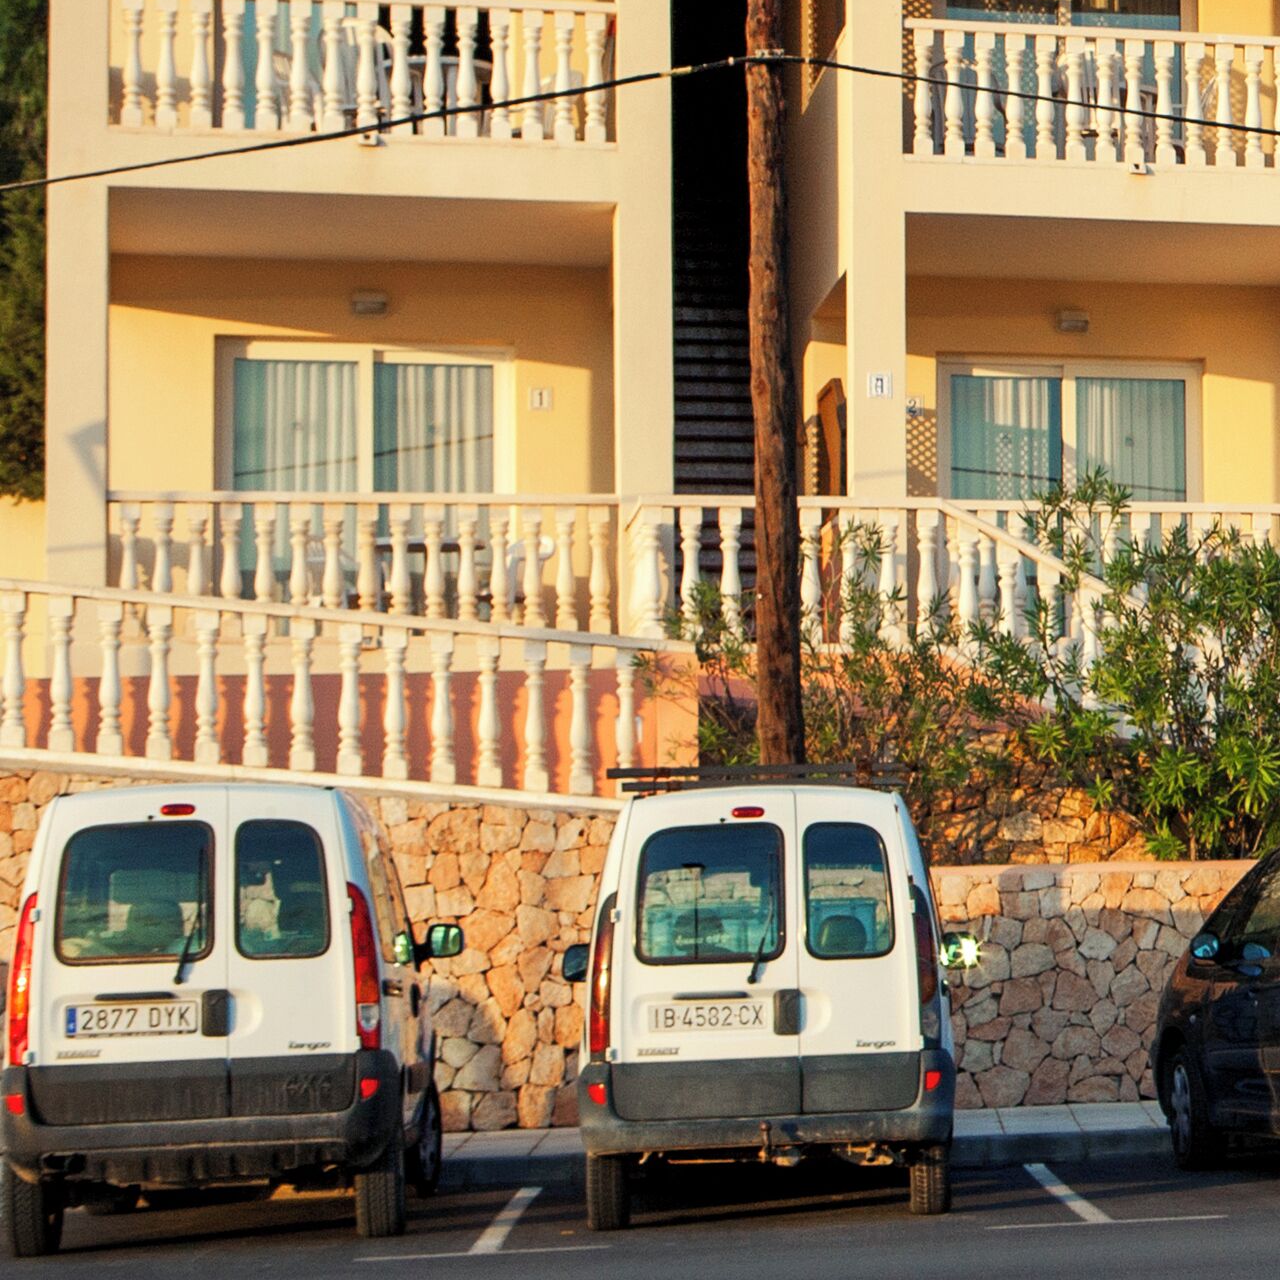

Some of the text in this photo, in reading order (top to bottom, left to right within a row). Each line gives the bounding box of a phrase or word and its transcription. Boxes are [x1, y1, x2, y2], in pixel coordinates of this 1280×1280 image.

[908, 399, 917, 414] 2
[81, 1006, 190, 1031] 2877 DYK
